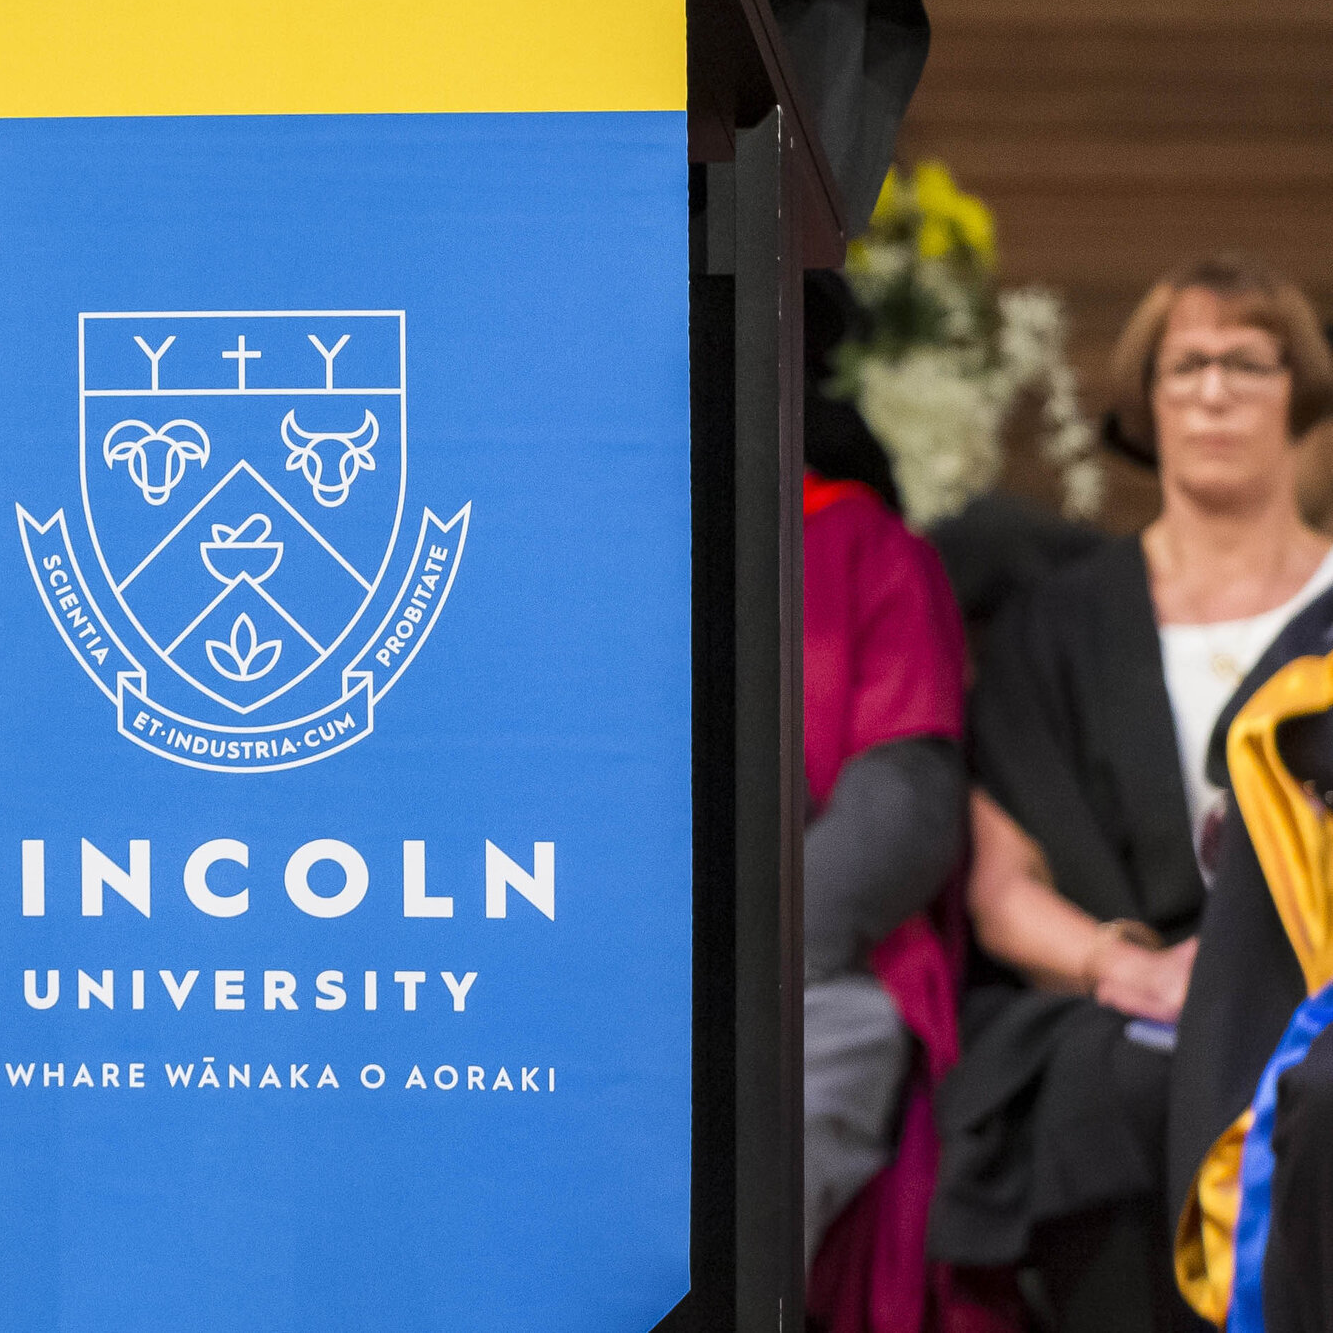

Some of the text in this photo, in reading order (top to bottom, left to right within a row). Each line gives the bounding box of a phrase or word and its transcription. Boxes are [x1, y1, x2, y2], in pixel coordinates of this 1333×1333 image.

[42, 554, 109, 666] SCIENTIA
[375, 544, 449, 667] PROBITATE
[23, 969, 478, 1012] UNIVERSITY
[5, 1062, 145, 1088] WHARE
[164, 1056, 340, 1089] WĀNAKA
[360, 1063, 386, 1089] O
[404, 1064, 555, 1092] AORAKI
